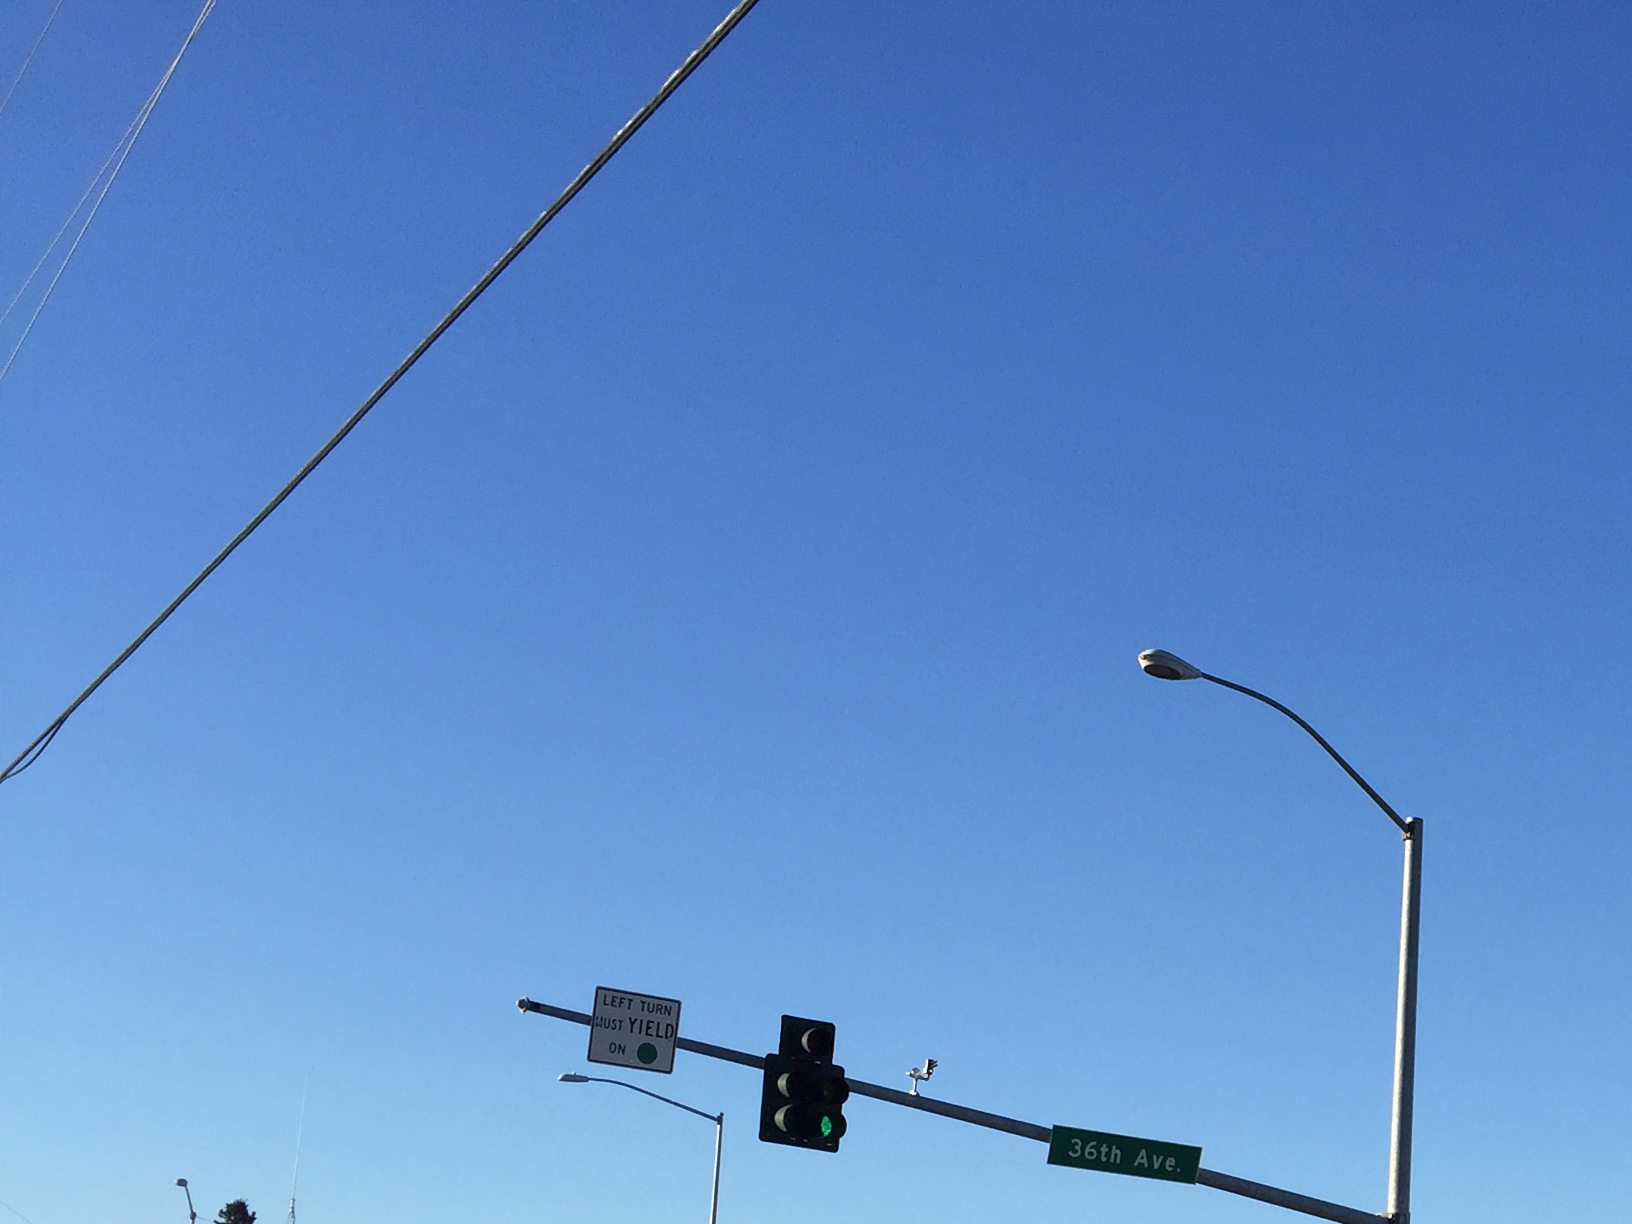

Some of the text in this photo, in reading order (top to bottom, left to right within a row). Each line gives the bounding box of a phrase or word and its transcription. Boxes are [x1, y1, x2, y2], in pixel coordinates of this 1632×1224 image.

[603, 994, 672, 1016] LEFT TURN
[628, 1017, 674, 1039] YIELD
[609, 1042, 626, 1055] ON
[1068, 1138, 1181, 1173] 36th Ave.
